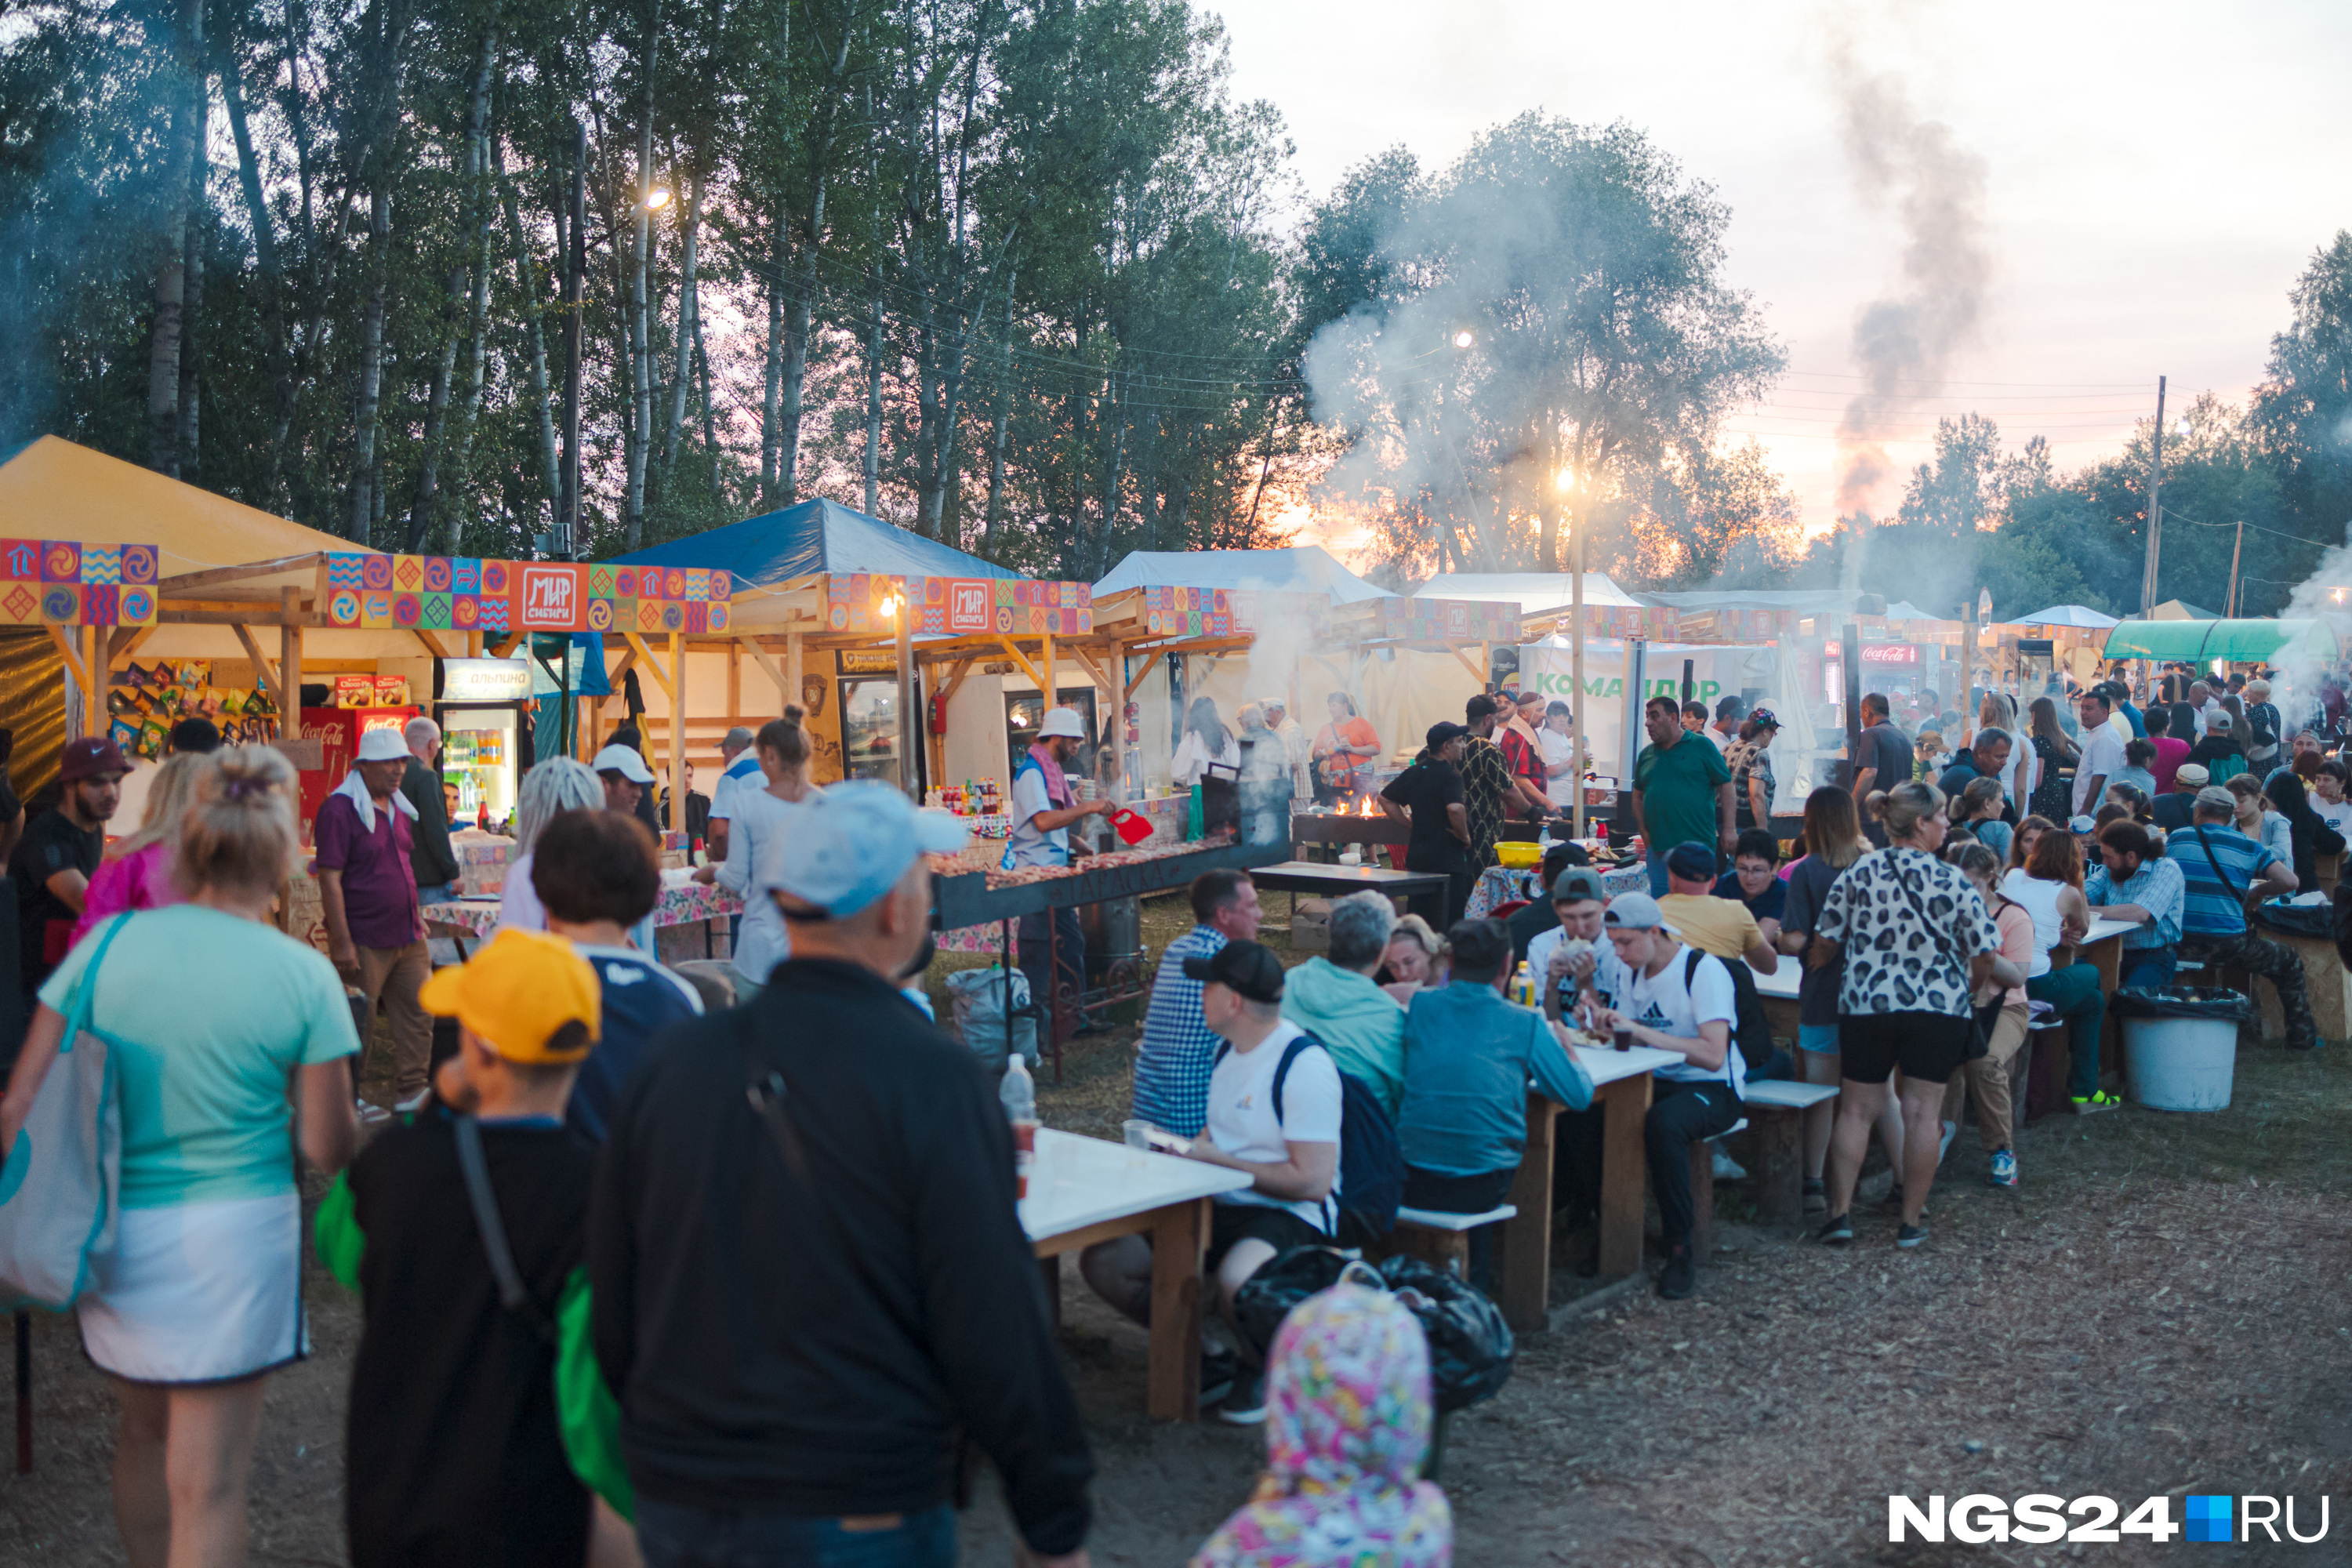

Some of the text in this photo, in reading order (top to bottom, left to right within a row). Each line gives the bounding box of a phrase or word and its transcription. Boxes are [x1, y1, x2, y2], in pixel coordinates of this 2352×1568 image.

[528, 576, 571, 607] МИР
[956, 590, 984, 614] МИР
[528, 607, 569, 619] СИБИРИ
[956, 615, 983, 623] СИБИРИ
[470, 673, 526, 684] альпина
